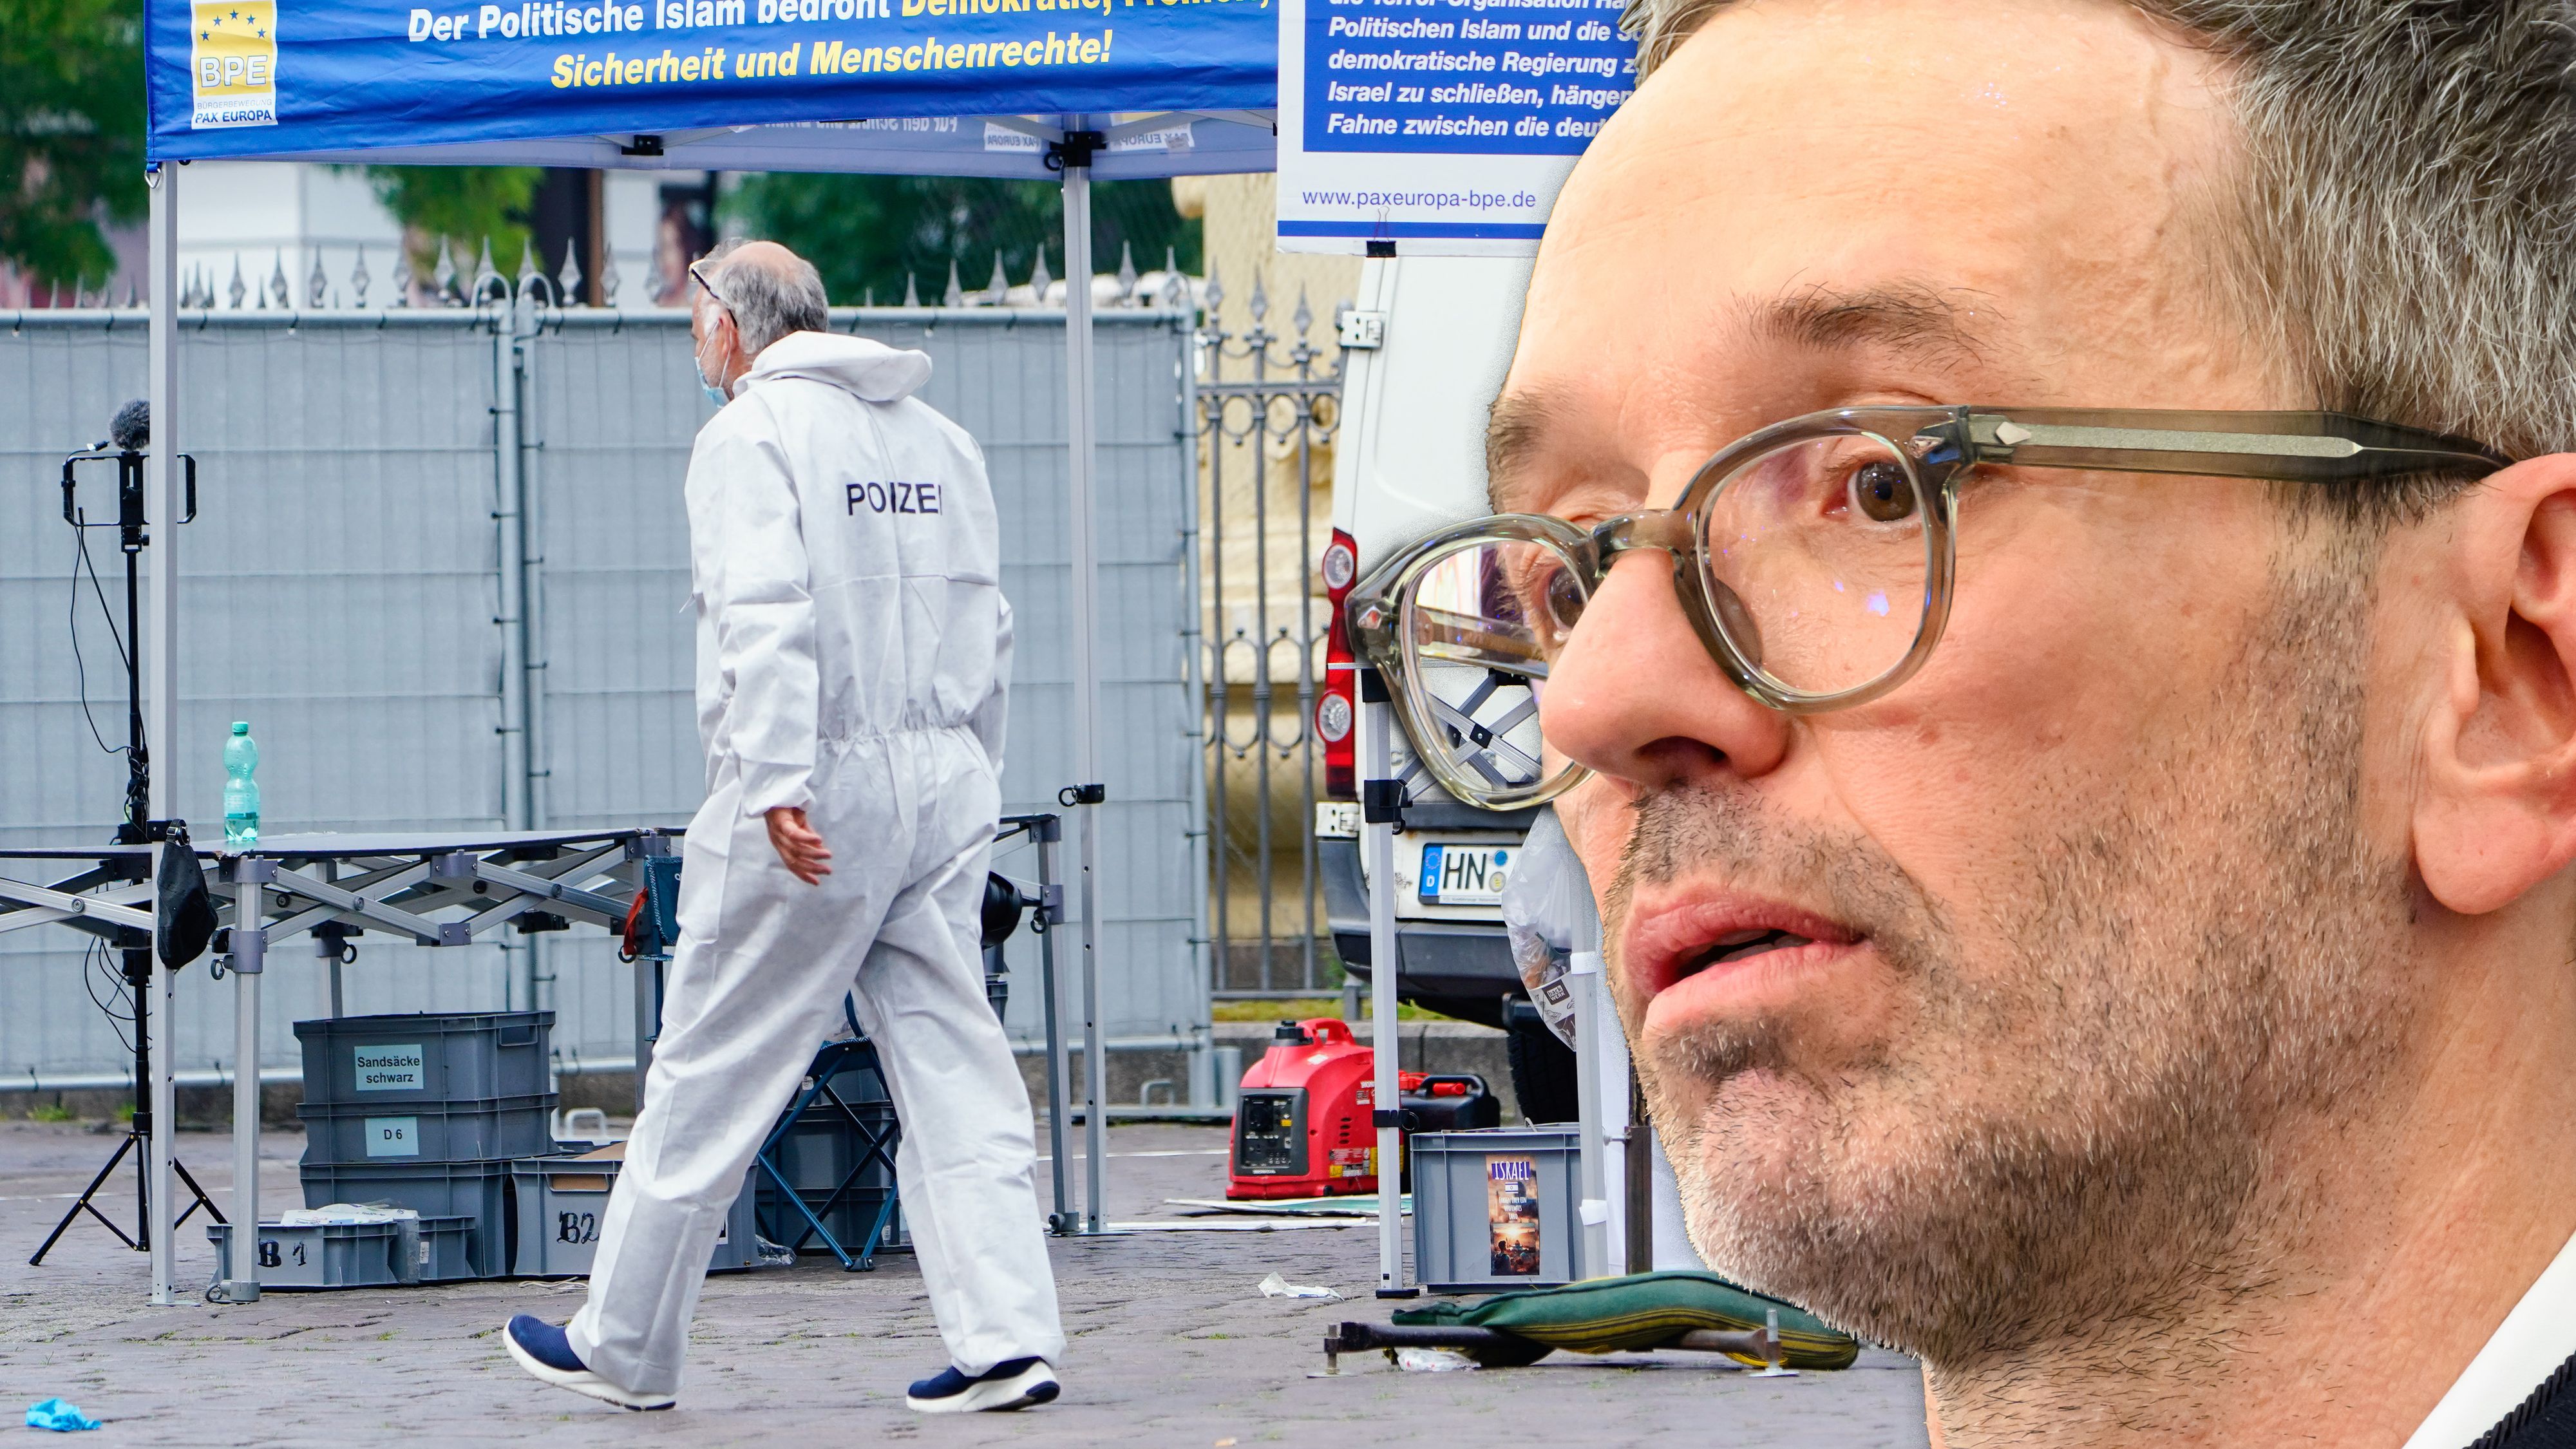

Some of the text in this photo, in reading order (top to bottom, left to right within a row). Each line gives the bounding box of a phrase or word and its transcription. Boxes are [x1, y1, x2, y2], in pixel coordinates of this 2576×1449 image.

[409, 8, 469, 43] Der
[478, 0, 644, 39] Politische
[656, 0, 745, 30] Islam
[1328, 17, 1455, 39] Politischen
[1460, 19, 1522, 40] Islam
[1527, 21, 1572, 41] und
[1576, 21, 1611, 42] die
[200, 55, 268, 88] BPE
[551, 29, 1113, 89] Sicherheit und Menschenrechte!
[1328, 49, 1640, 78] demokratische Regierung z
[197, 99, 272, 109] BÜRGERBEWEGUNG
[1327, 81, 1393, 102] Israel
[1396, 86, 1425, 103] zu
[1430, 83, 1544, 109] schließen,
[195, 109, 272, 123] PAX EUROPA
[1327, 113, 1398, 135] Fahne
[1403, 115, 1509, 136] zwischen
[1514, 117, 1549, 137] die
[1302, 190, 1536, 211] www.paxeuropa-bpe.de
[1426, 853, 1487, 889] D HN
[357, 1056, 421, 1068] Sandsäcke
[366, 1072, 414, 1083] schwarz
[384, 1129, 402, 1140] D 6
[1493, 1160, 1530, 1181] ISRAEL
[556, 1211, 600, 1244] B2
[292, 1240, 308, 1267] 1
